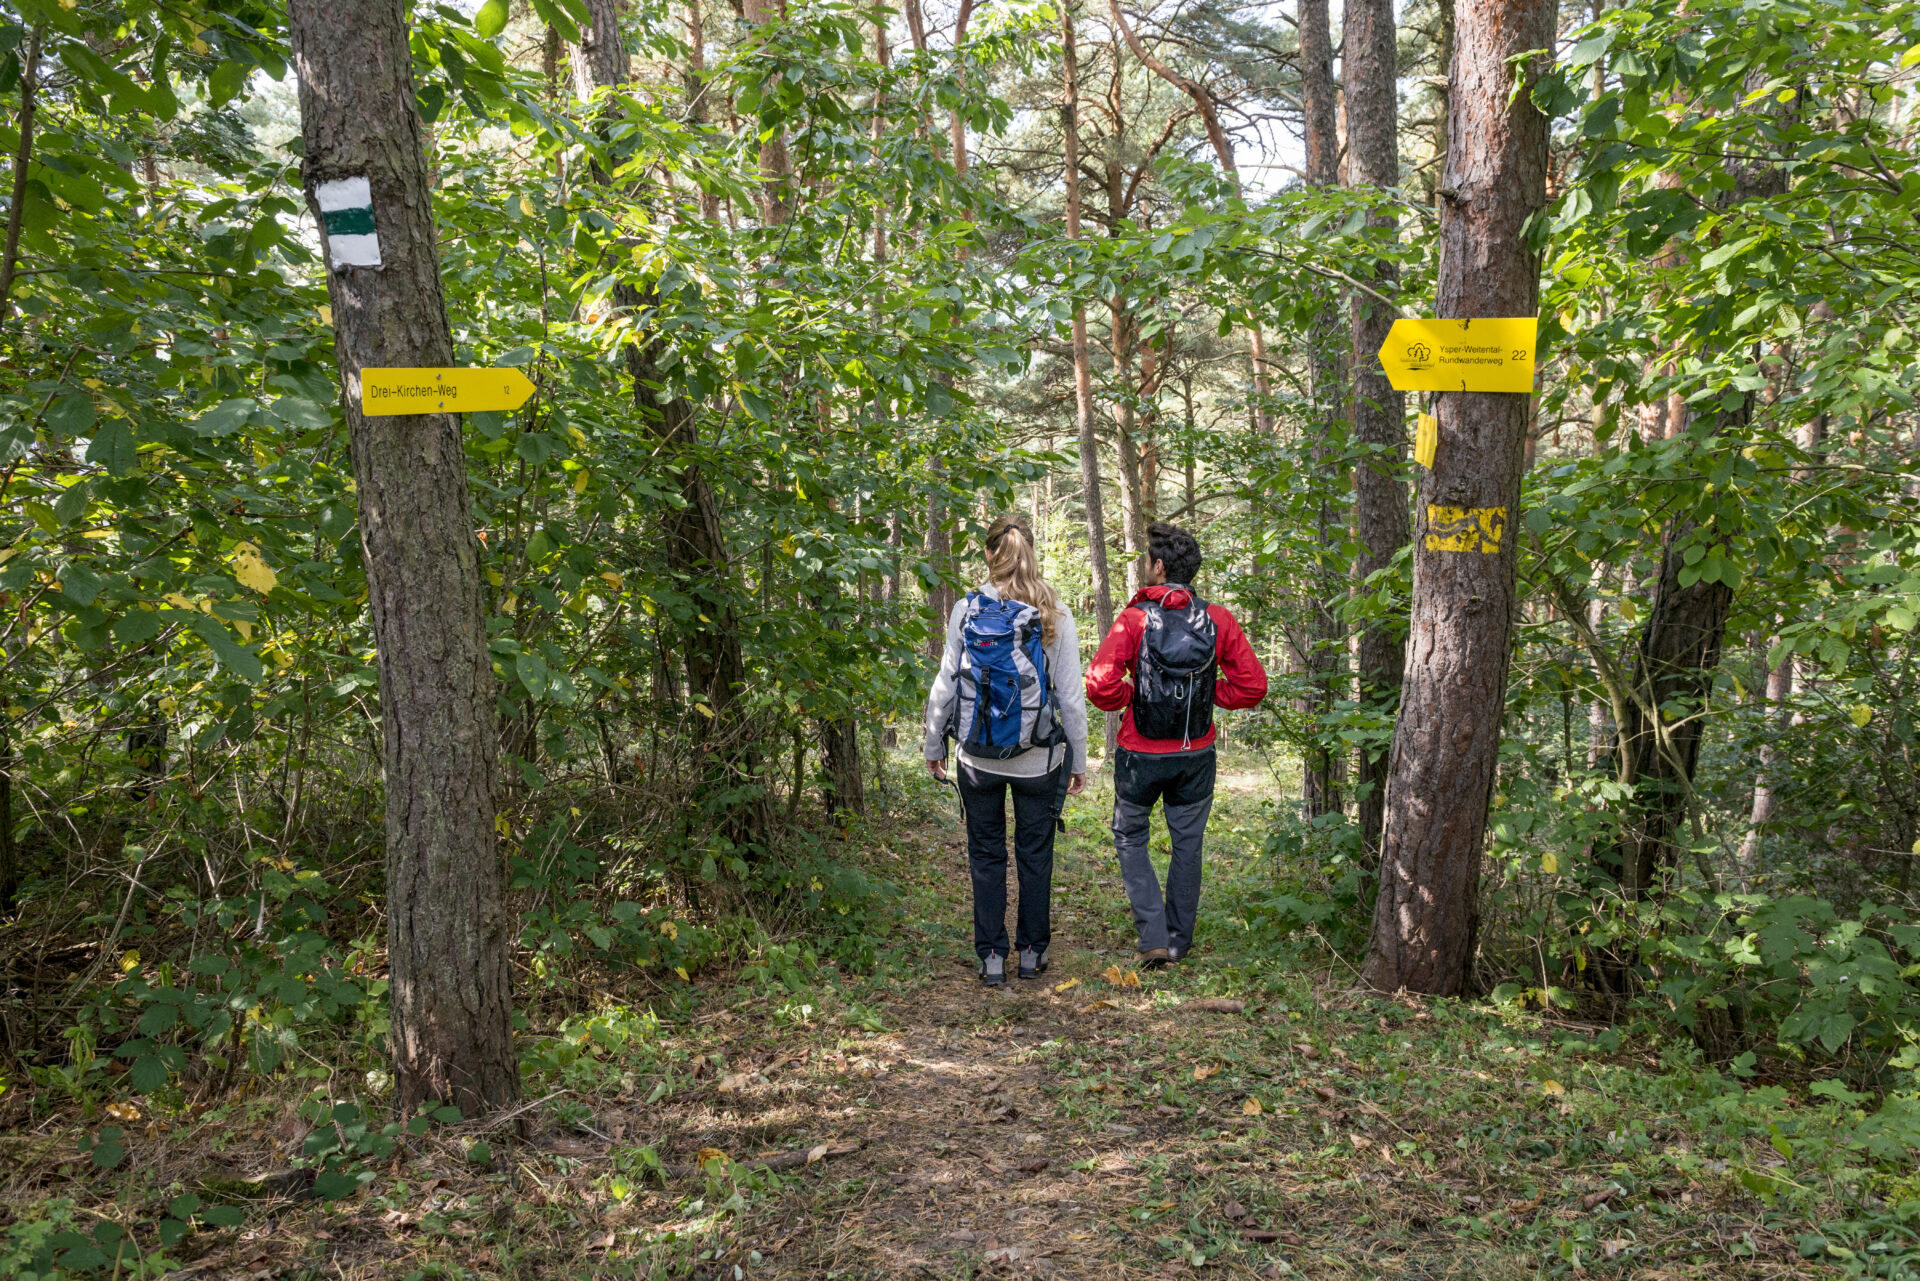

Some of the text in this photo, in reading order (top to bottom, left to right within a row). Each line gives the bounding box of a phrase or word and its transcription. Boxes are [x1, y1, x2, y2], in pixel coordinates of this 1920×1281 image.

[1440, 346, 1503, 355] Ysper-Weitental-
[1439, 356, 1503, 366] Rundwanderweg
[1511, 351, 1527, 361] 22
[371, 384, 457, 398] Drei-Kirchen-Weg
